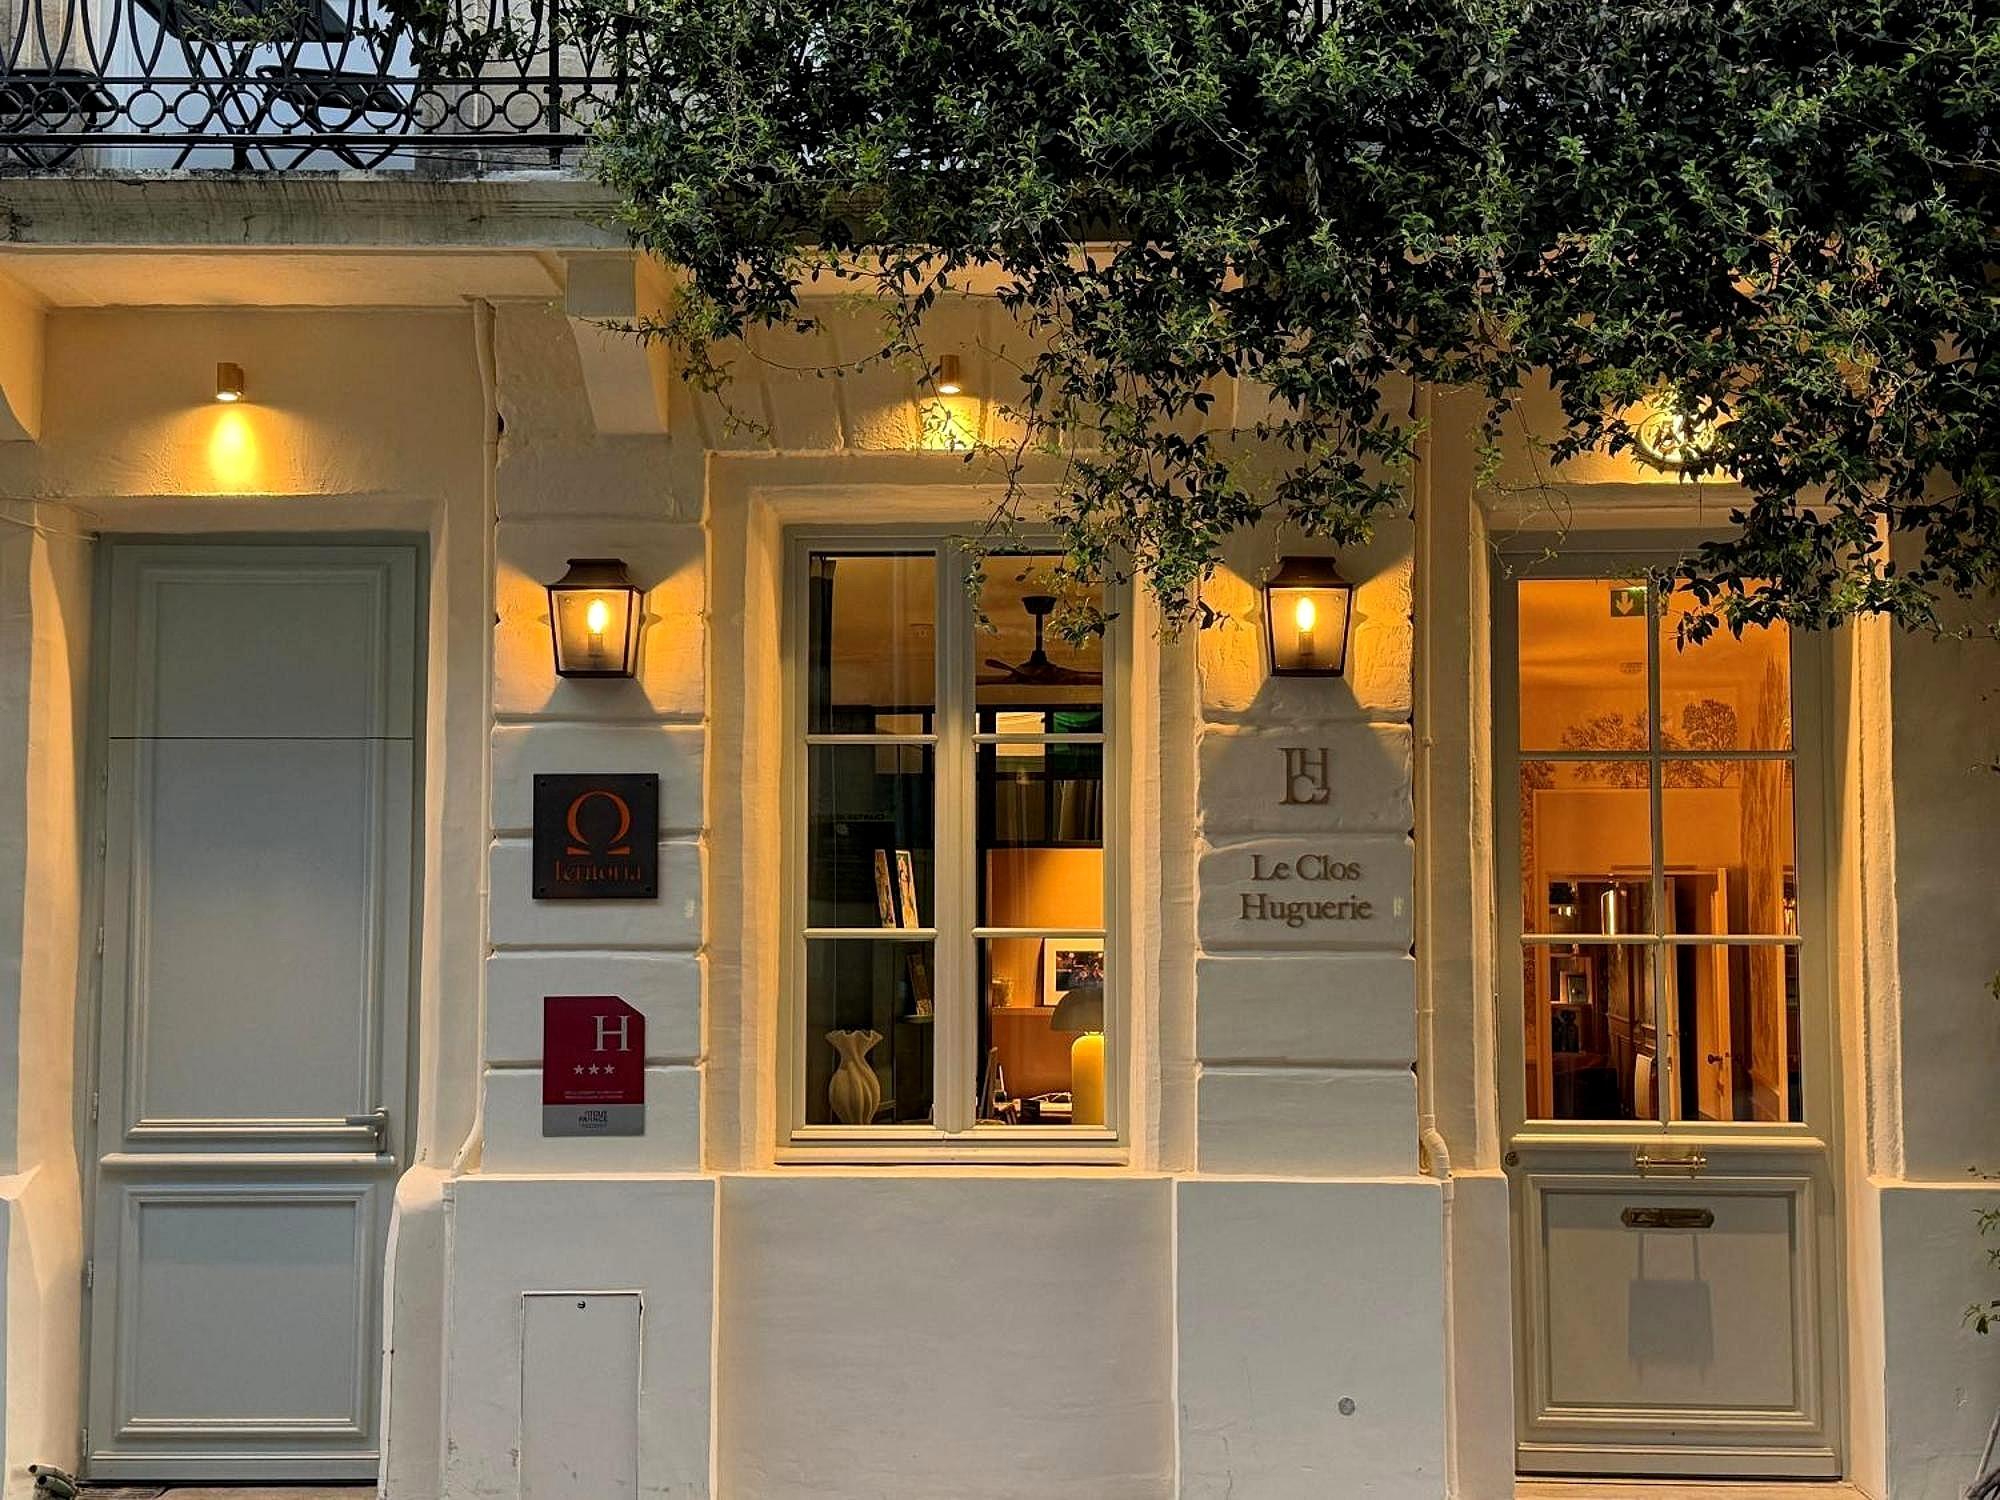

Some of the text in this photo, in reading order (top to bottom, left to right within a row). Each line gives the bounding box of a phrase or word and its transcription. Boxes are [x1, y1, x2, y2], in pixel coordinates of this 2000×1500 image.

[1251, 854, 1361, 881] Le Clos
[1239, 893, 1373, 928] Huguerie
[592, 1015, 631, 1052] H
